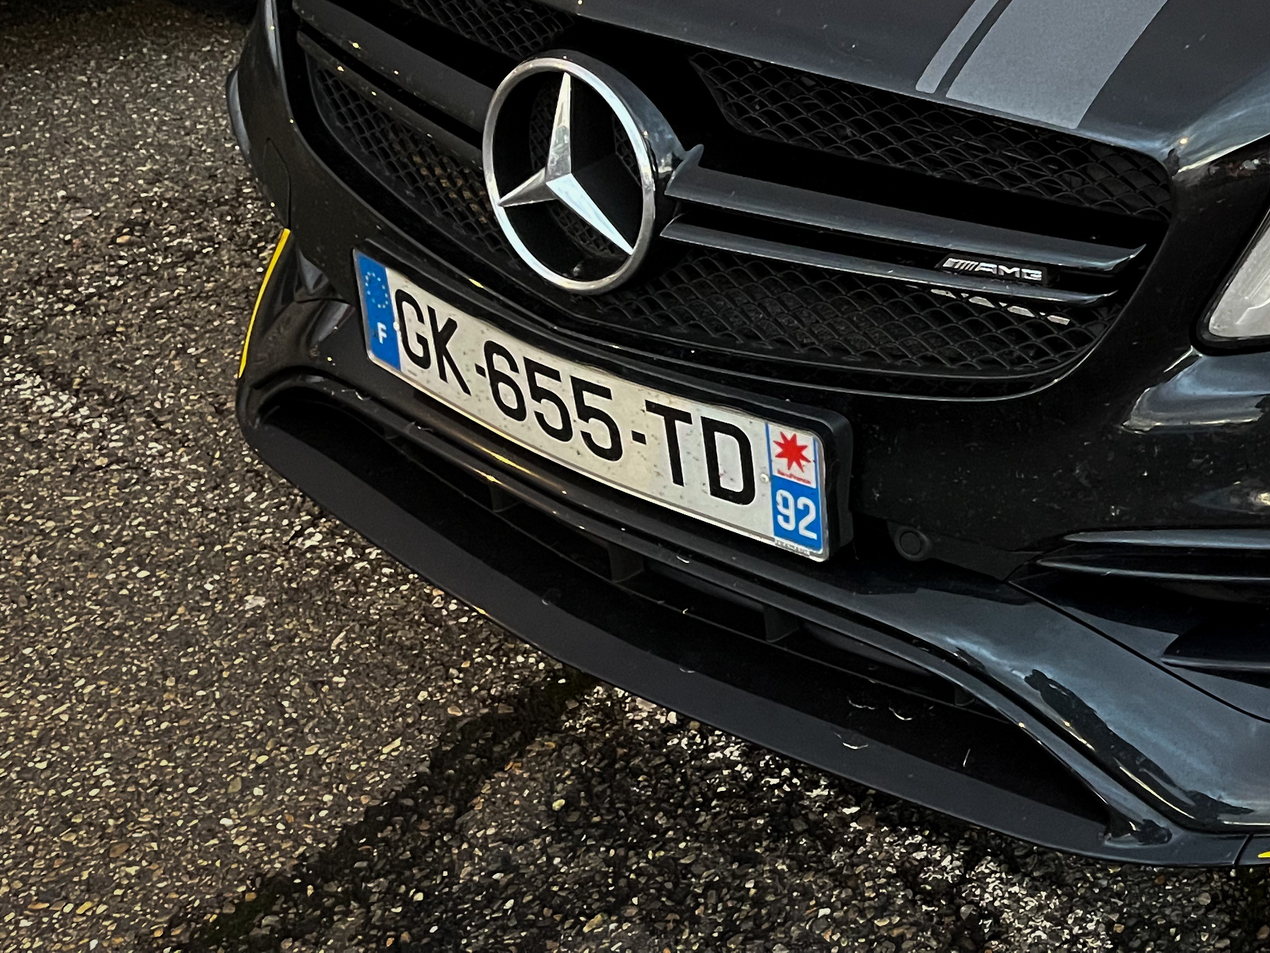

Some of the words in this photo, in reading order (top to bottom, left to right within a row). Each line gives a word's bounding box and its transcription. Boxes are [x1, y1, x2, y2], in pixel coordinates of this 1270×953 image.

[970, 261, 1043, 281] AMG
[376, 321, 388, 345] F
[394, 288, 756, 506] GK-655-TD
[775, 488, 818, 541] 92
